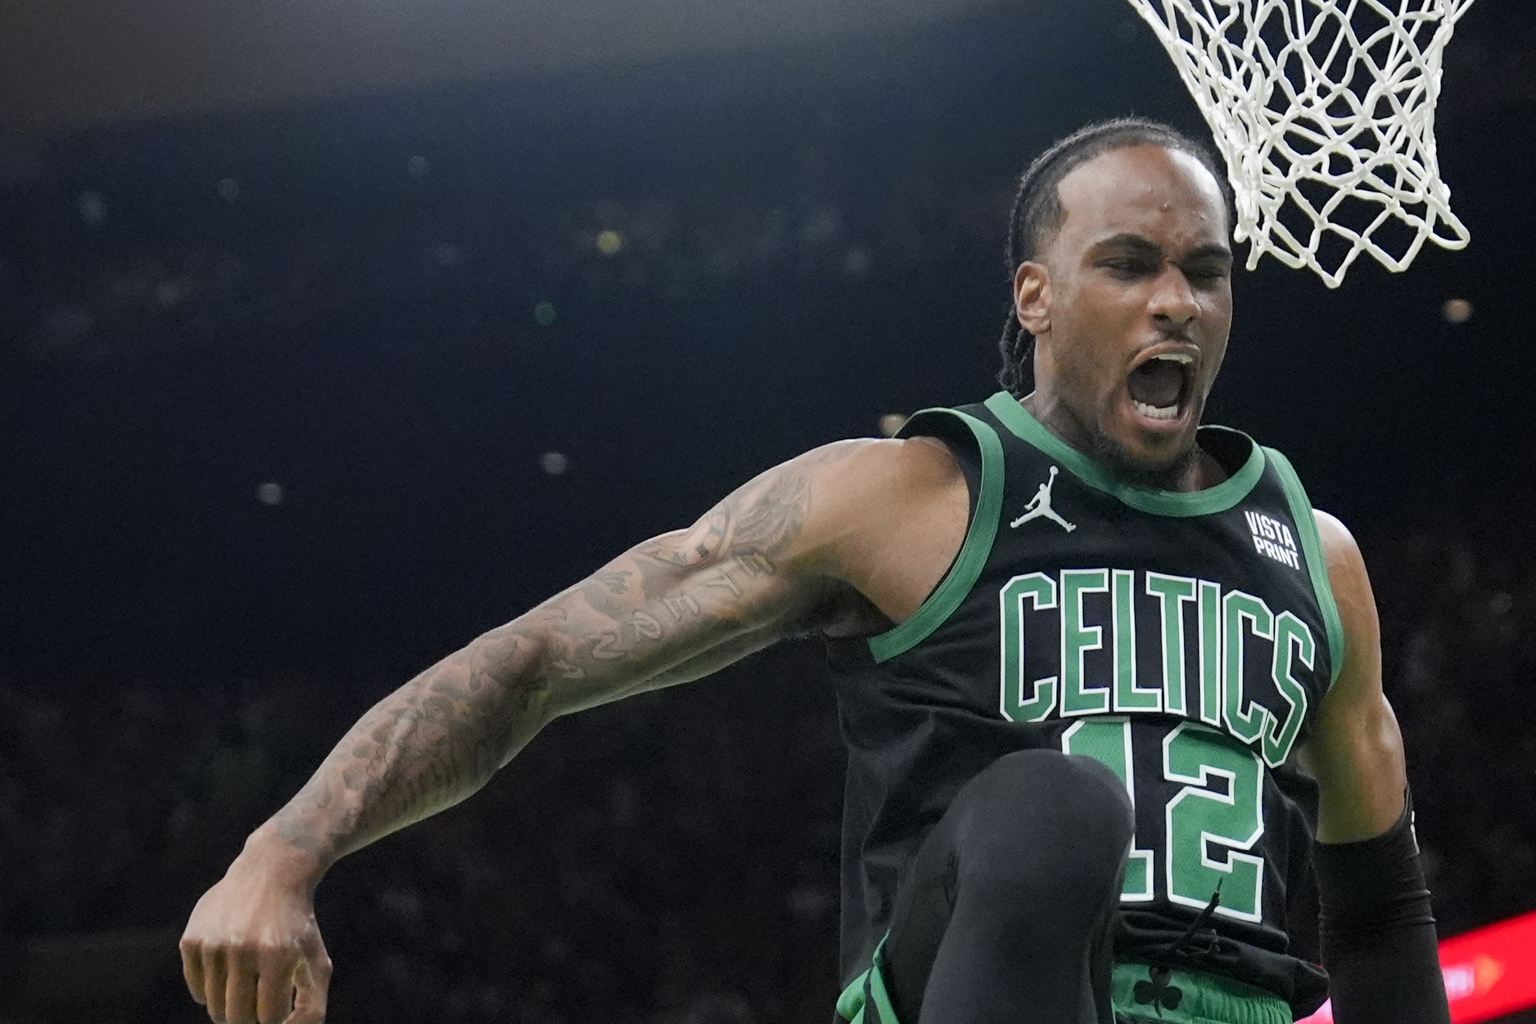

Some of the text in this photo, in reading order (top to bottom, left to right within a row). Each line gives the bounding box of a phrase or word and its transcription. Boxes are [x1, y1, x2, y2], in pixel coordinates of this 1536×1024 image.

[1244, 510, 1297, 552] VISTA
[1252, 534, 1300, 571] PRINT
[1000, 567, 1316, 769] CELTICS
[1061, 715, 1265, 924] 12
